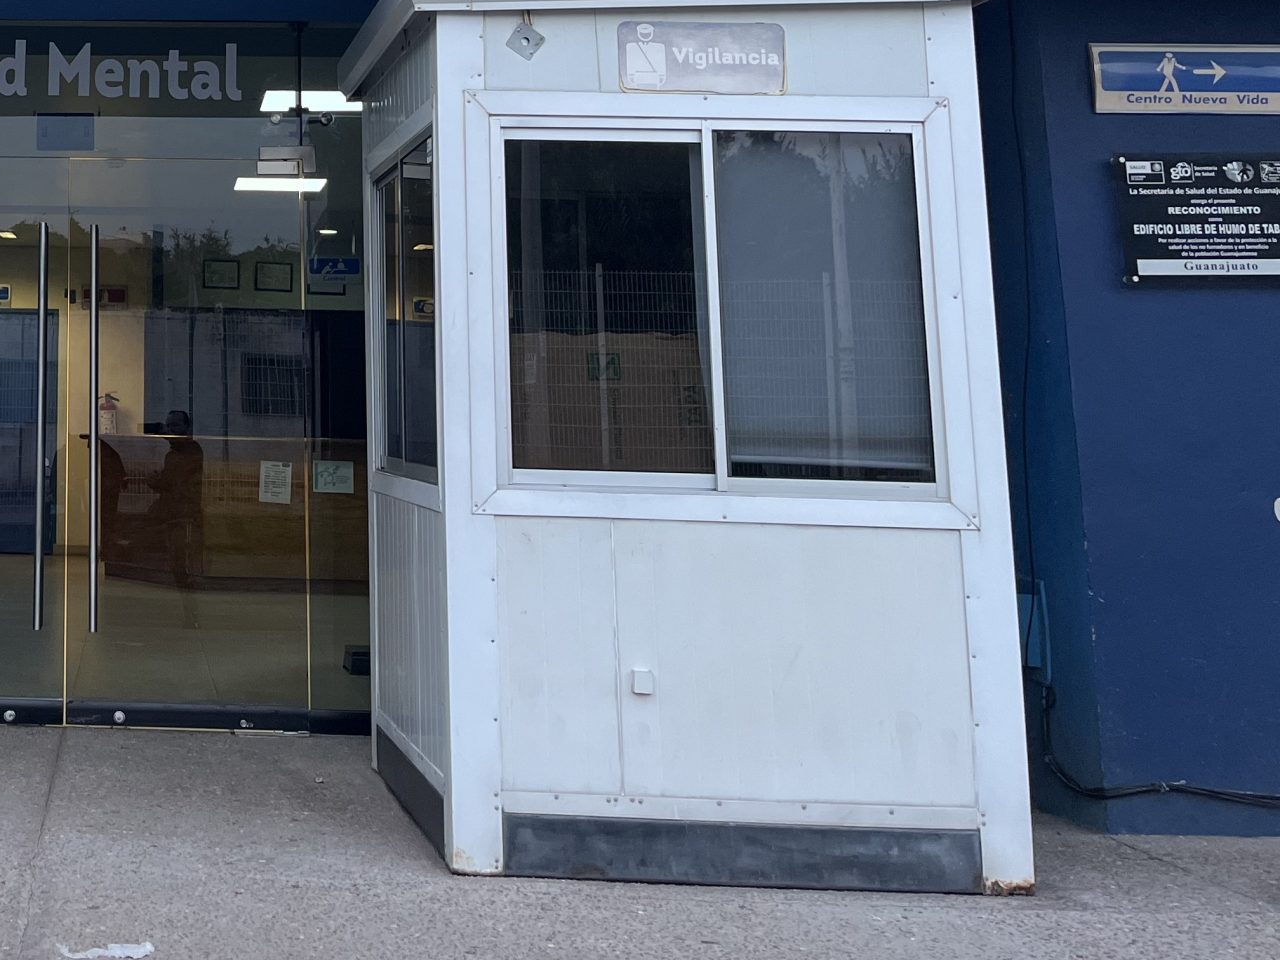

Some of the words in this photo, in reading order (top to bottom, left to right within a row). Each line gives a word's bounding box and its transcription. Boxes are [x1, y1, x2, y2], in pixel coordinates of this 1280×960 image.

[672, 48, 779, 69] Vigilancia
[47, 41, 242, 101] Mental
[1126, 94, 1173, 104] Centro
[1182, 94, 1228, 105] Nueva
[1236, 94, 1269, 105] Vida
[1168, 206, 1261, 214] RECONOCIMIENTO
[1133, 224, 1174, 234] EDIFICIO
[1175, 224, 1202, 234] LIBRE
[1204, 224, 1217, 234] DE
[1218, 224, 1246, 234] HUMO
[1248, 224, 1261, 234] DE
[1184, 262, 1258, 272] Guanajuato
